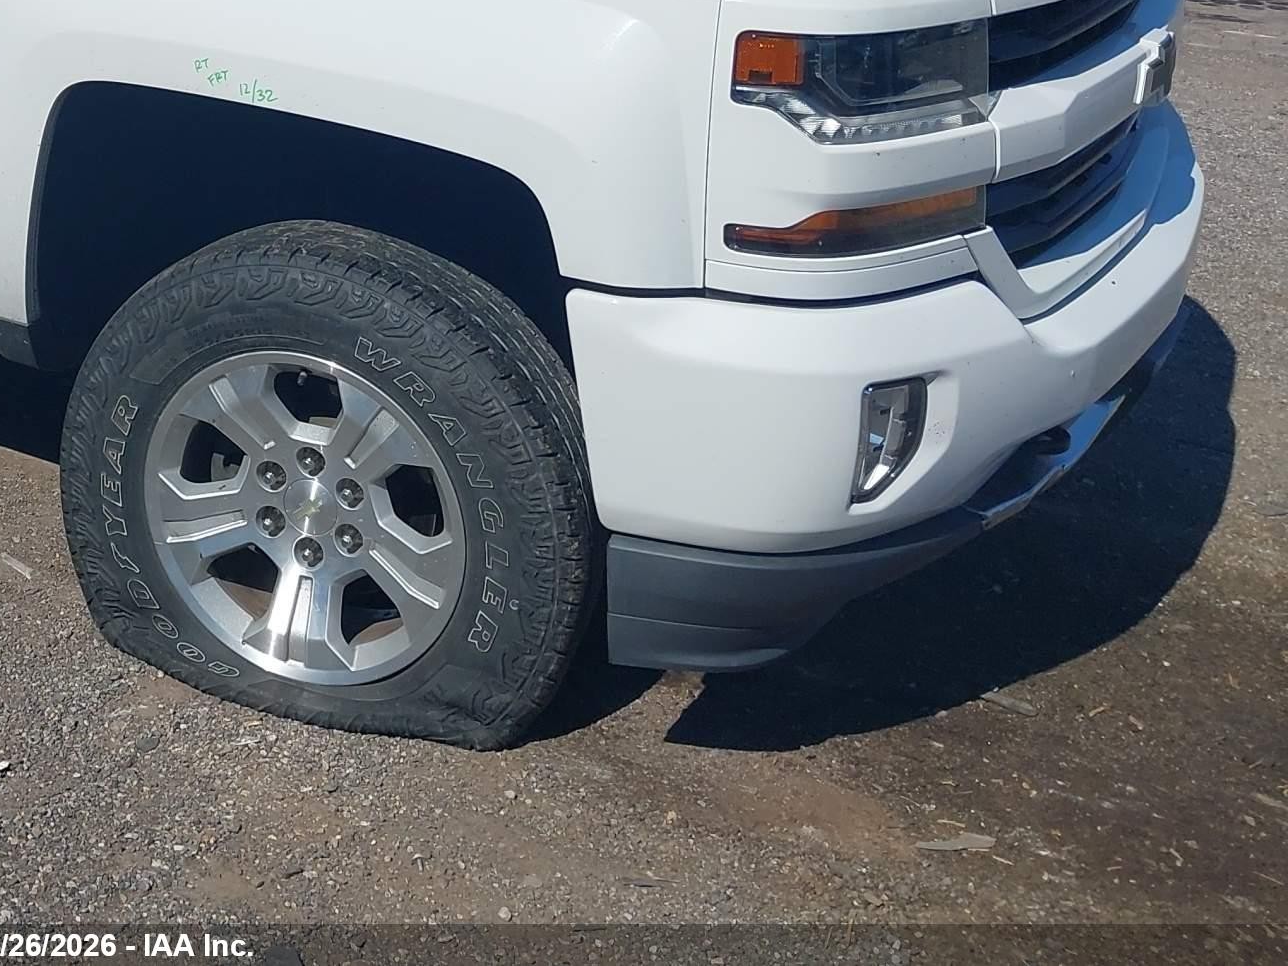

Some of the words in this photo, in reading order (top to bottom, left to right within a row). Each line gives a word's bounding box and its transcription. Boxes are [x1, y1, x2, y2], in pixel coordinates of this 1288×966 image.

[207, 69, 229, 87] FRT
[239, 78, 278, 103] 12/32
[98, 394, 241, 678] GOODYEAR
[354, 336, 509, 654] WRANGLER
